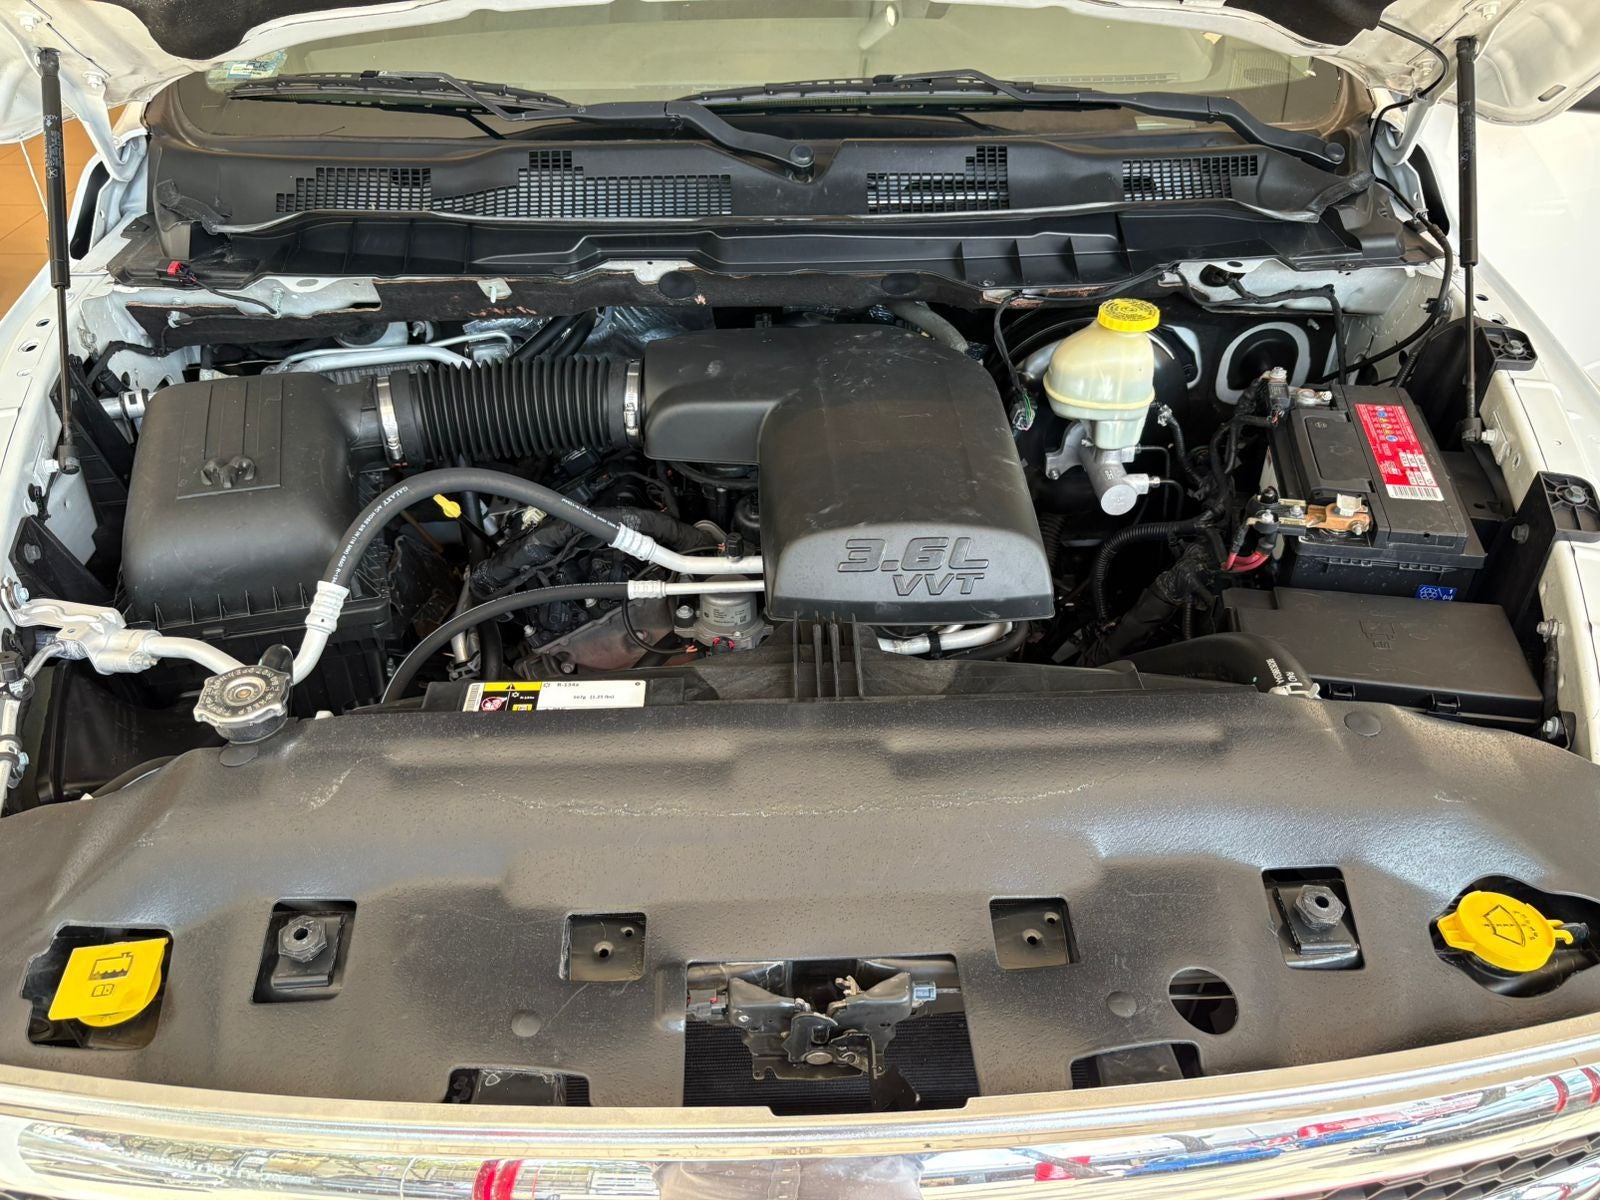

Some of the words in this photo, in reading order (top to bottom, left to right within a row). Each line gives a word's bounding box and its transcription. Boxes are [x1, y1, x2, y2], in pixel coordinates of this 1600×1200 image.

[382, 485, 409, 507] GALAXY
[363, 511, 376, 525] HOSE
[837, 536, 990, 573] 3.6L
[892, 572, 985, 597] VVT
